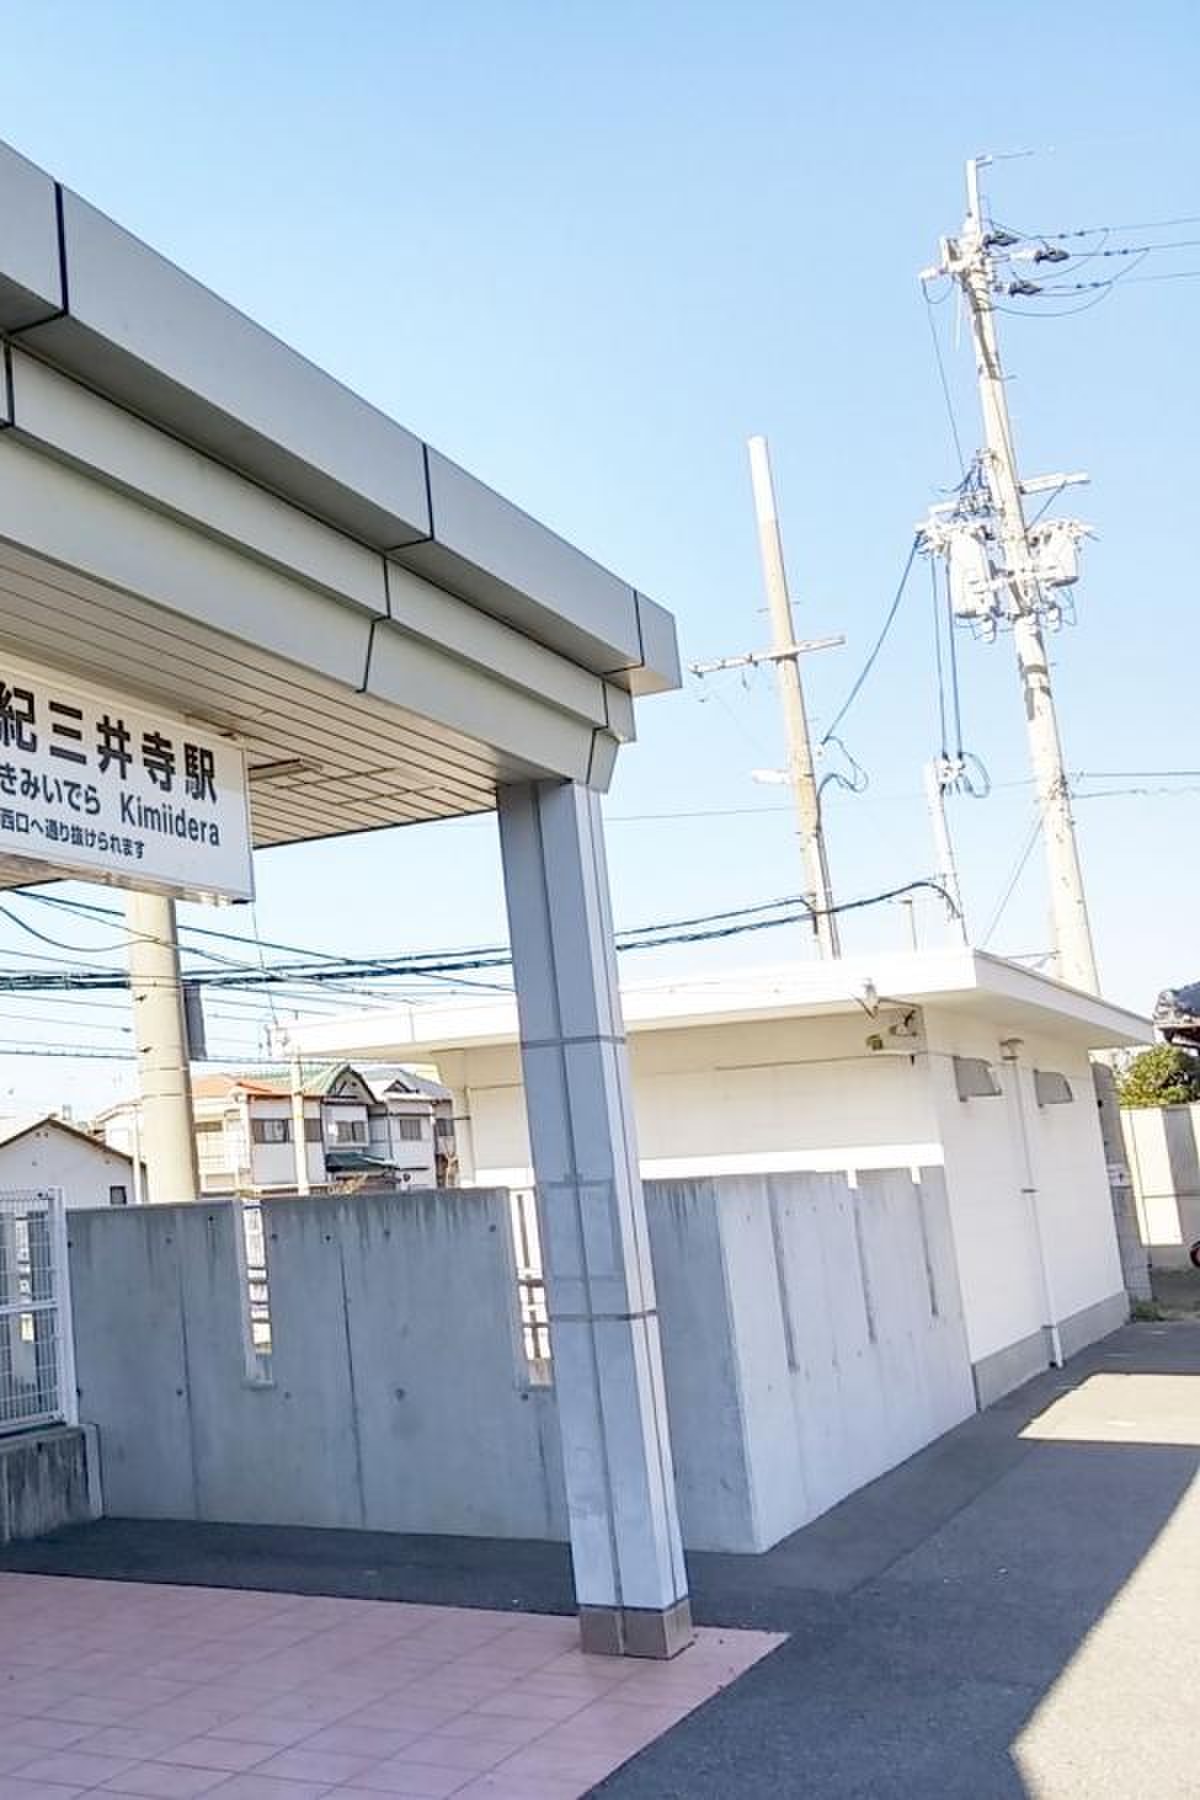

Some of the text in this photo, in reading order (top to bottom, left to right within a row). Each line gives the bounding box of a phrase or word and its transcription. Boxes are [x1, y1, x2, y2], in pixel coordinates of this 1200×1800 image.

[0, 807, 145, 859] 西口へ通り抜けられます
[120, 791, 220, 847] Kimiidera
